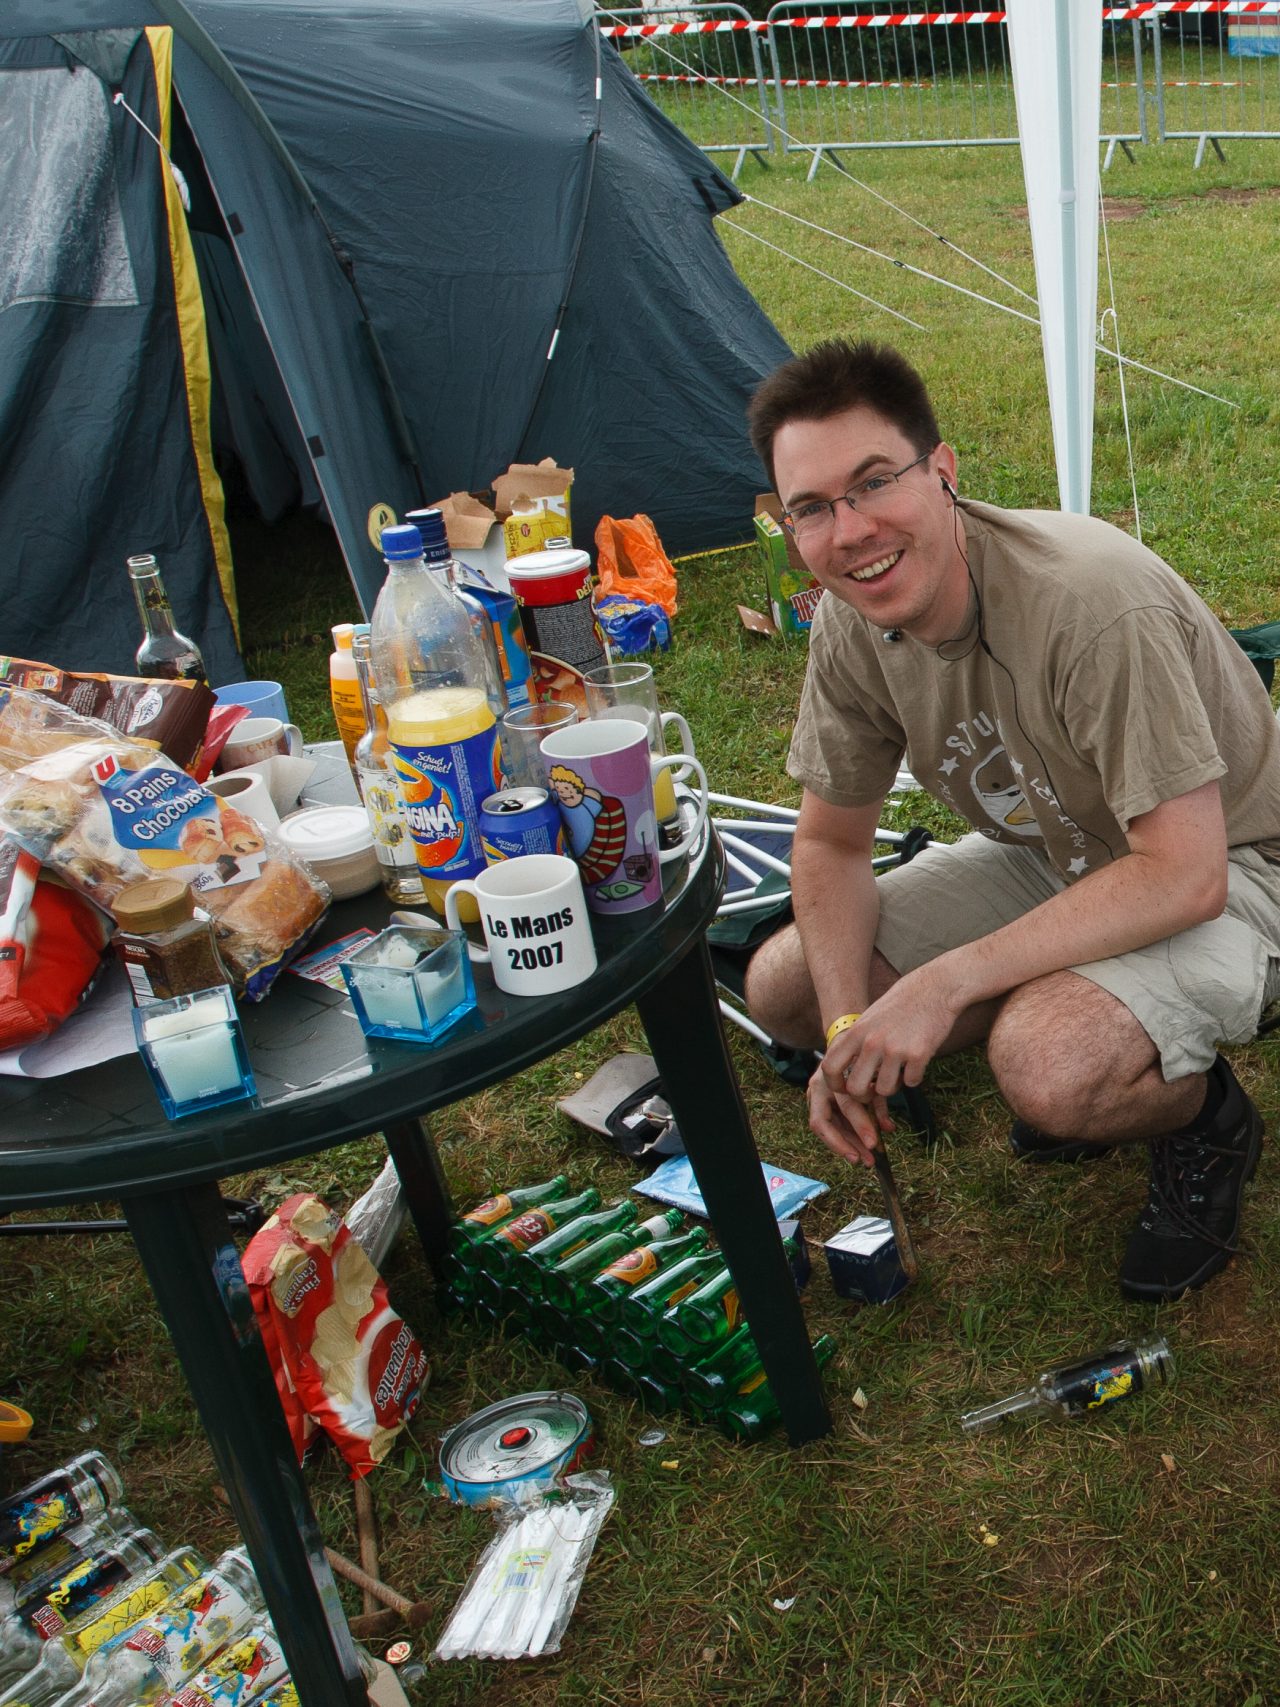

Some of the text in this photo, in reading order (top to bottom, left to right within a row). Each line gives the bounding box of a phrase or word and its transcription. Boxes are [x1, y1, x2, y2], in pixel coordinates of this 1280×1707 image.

[412, 758, 452, 774] en geniet!
[418, 751, 444, 765] Schud
[111, 798, 136, 814] 8
[126, 772, 177, 806] Pains
[132, 787, 210, 840] Chocolat
[437, 828, 461, 841] pulp!
[487, 907, 574, 939] Le Mans
[508, 941, 563, 970] 2007
